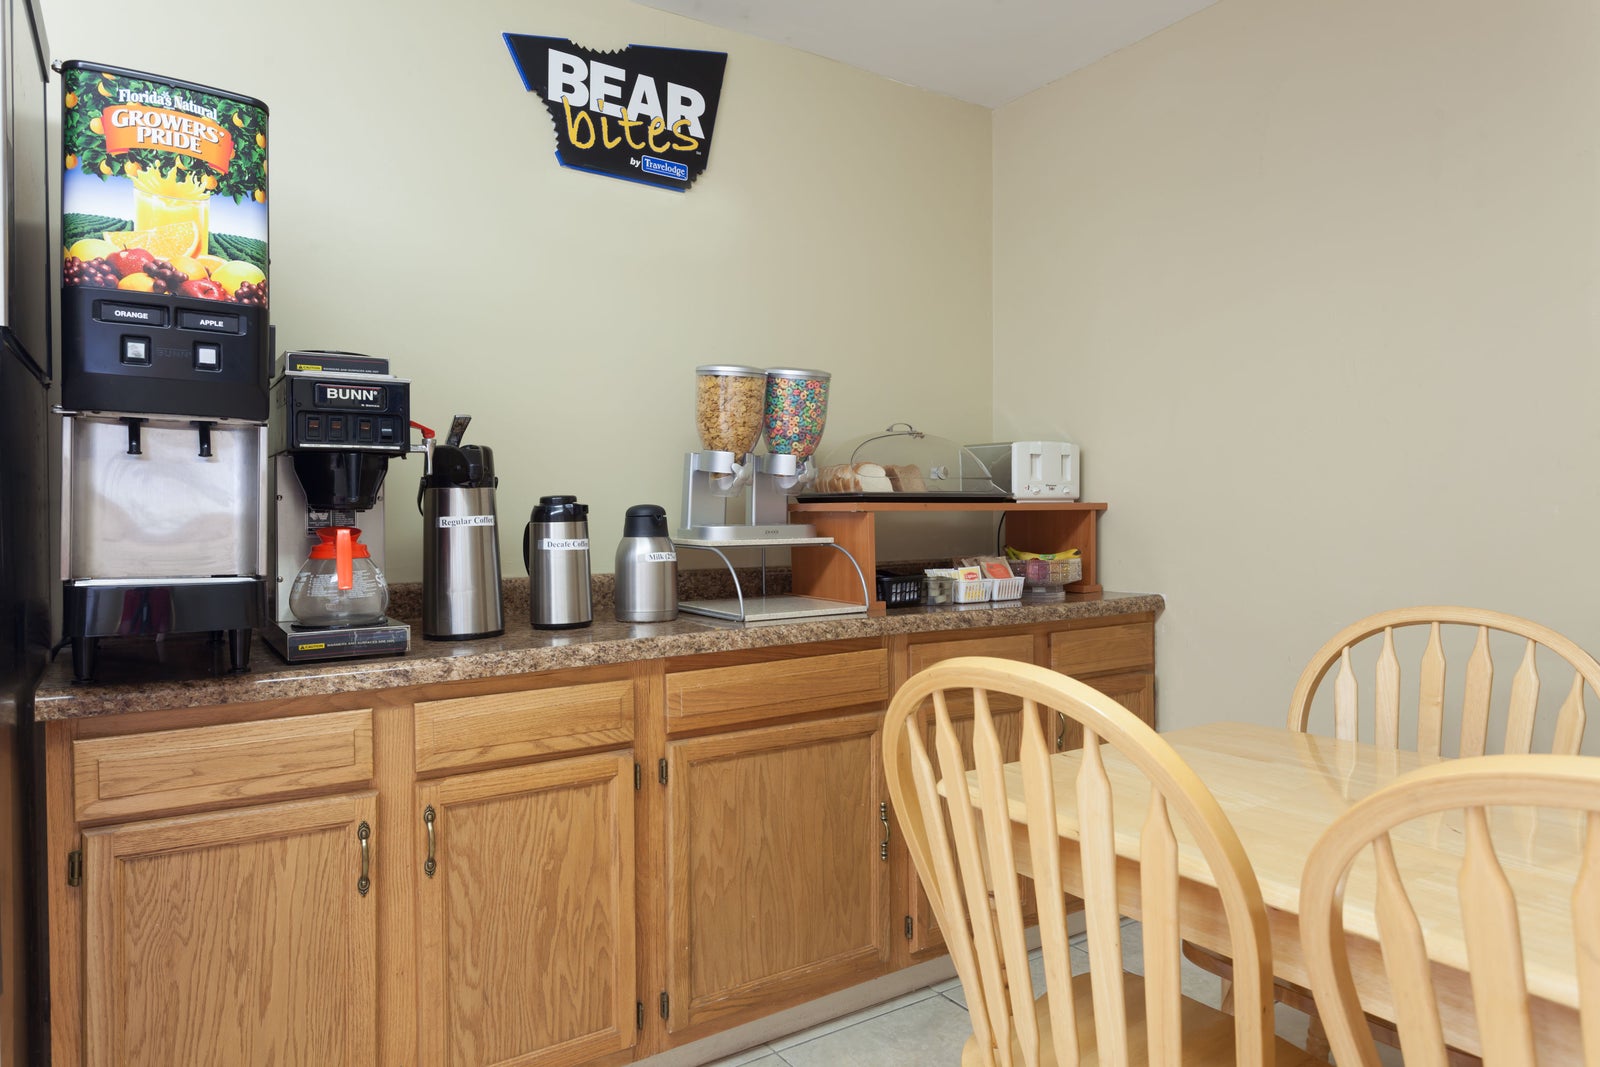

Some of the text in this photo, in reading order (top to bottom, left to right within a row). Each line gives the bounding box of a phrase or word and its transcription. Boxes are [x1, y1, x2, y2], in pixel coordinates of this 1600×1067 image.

[118, 88, 217, 120] Florida's Natural
[548, 48, 706, 139] BEAR
[561, 95, 699, 152] bites
[137, 126, 202, 154] PRIDE
[629, 156, 686, 177] by Travelodge
[115, 310, 149, 319] ORANGE
[200, 319, 224, 327] APPLE
[327, 388, 374, 400] BUNN
[441, 518, 471, 527] Regular
